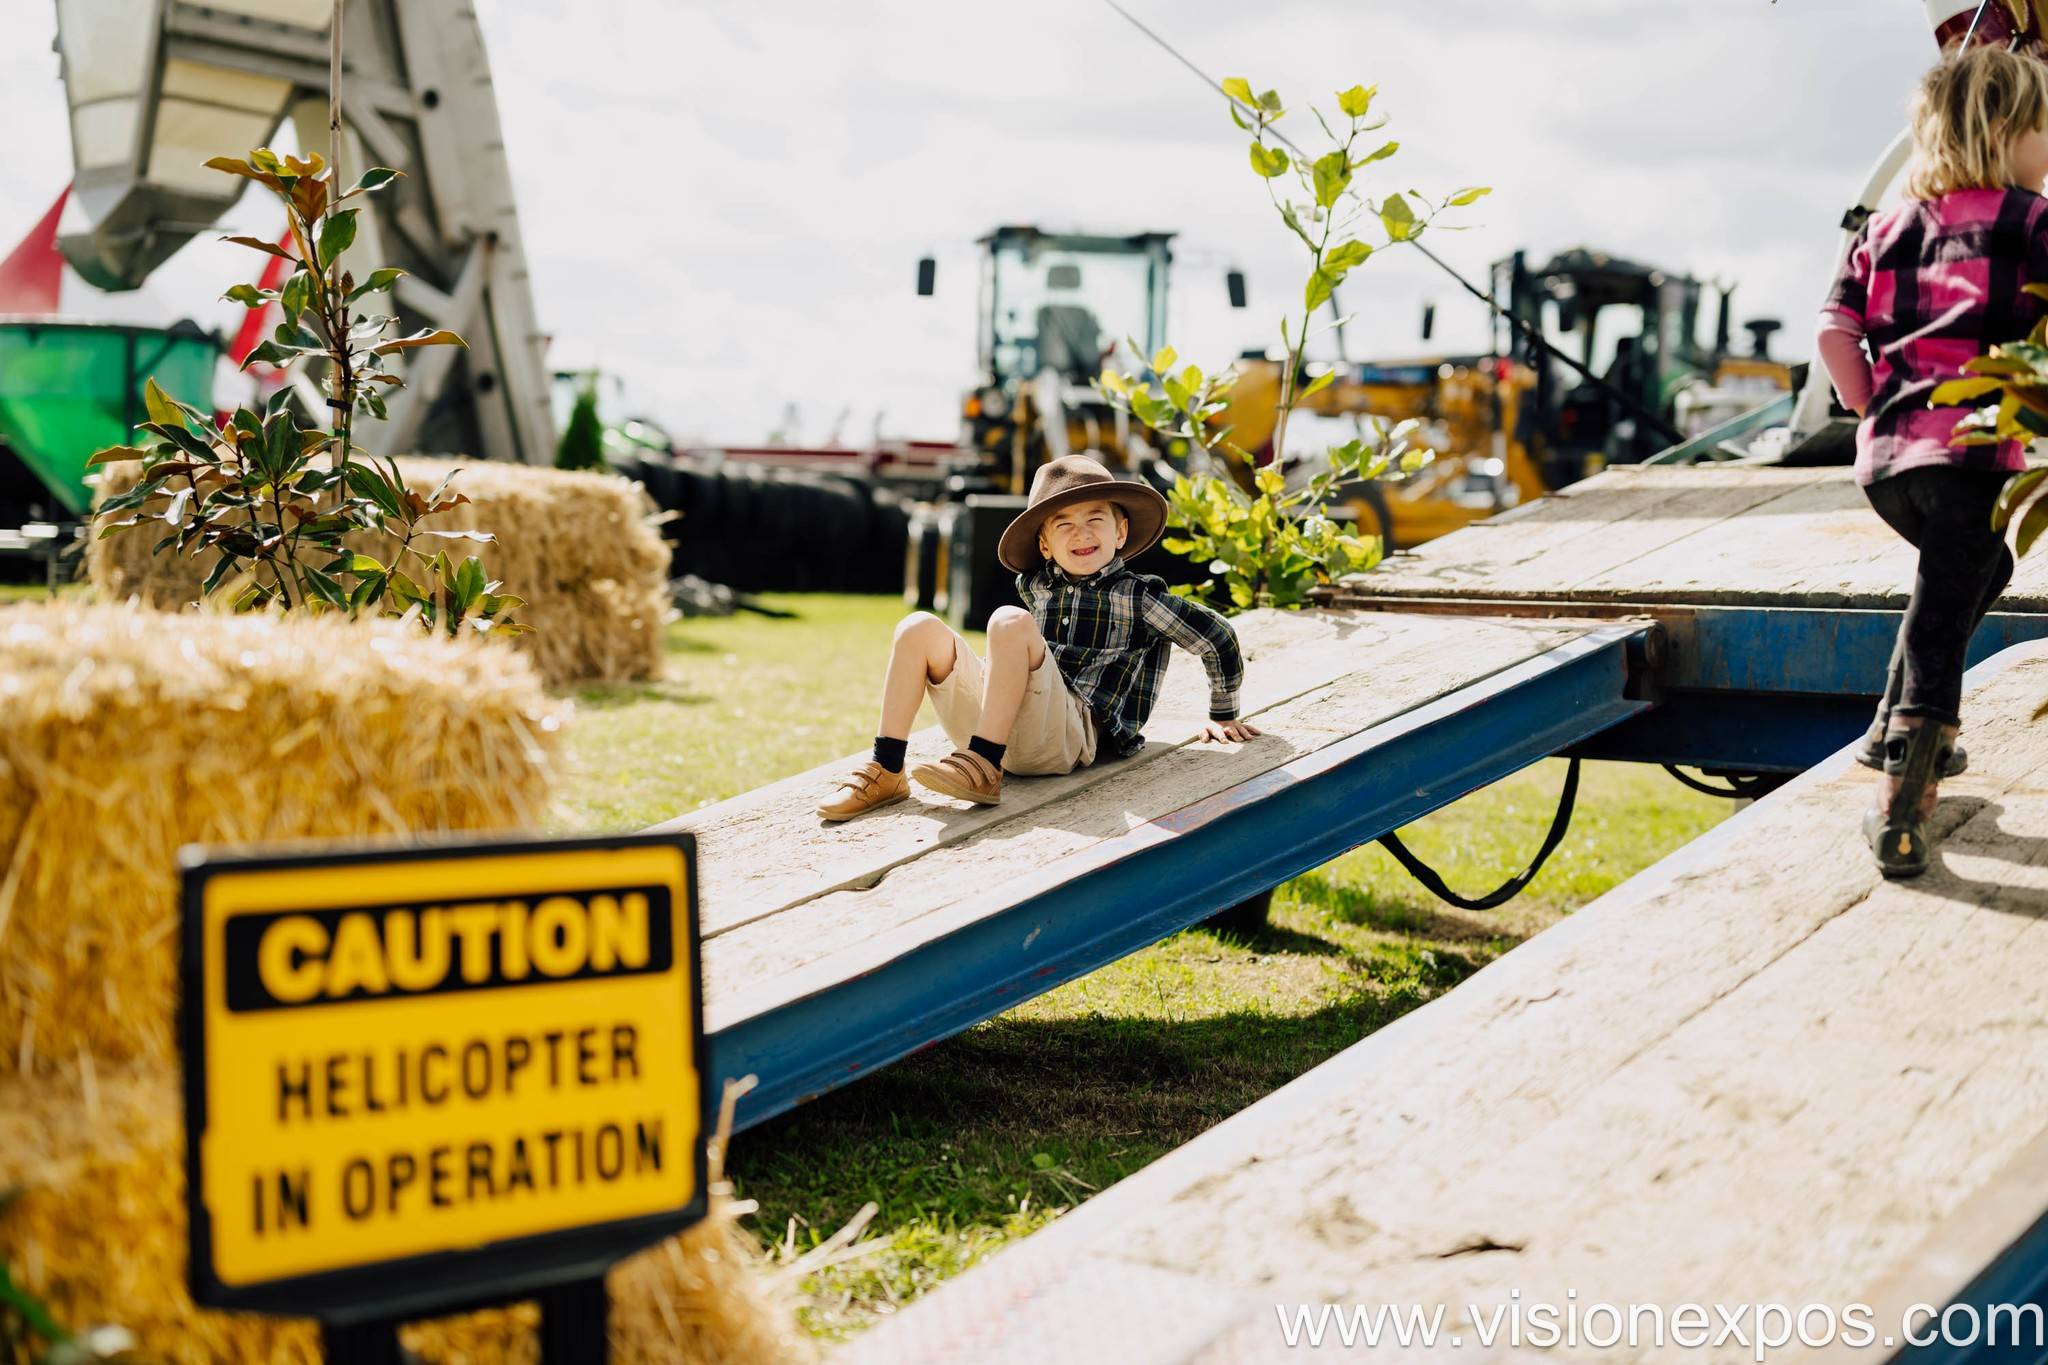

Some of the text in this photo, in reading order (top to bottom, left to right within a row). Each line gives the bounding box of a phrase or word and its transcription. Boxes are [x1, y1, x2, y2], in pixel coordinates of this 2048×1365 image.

[259, 894, 650, 1002] CAUTION
[277, 1025, 639, 1121] HELICOPTER
[252, 1121, 662, 1235] IN OPERATION
